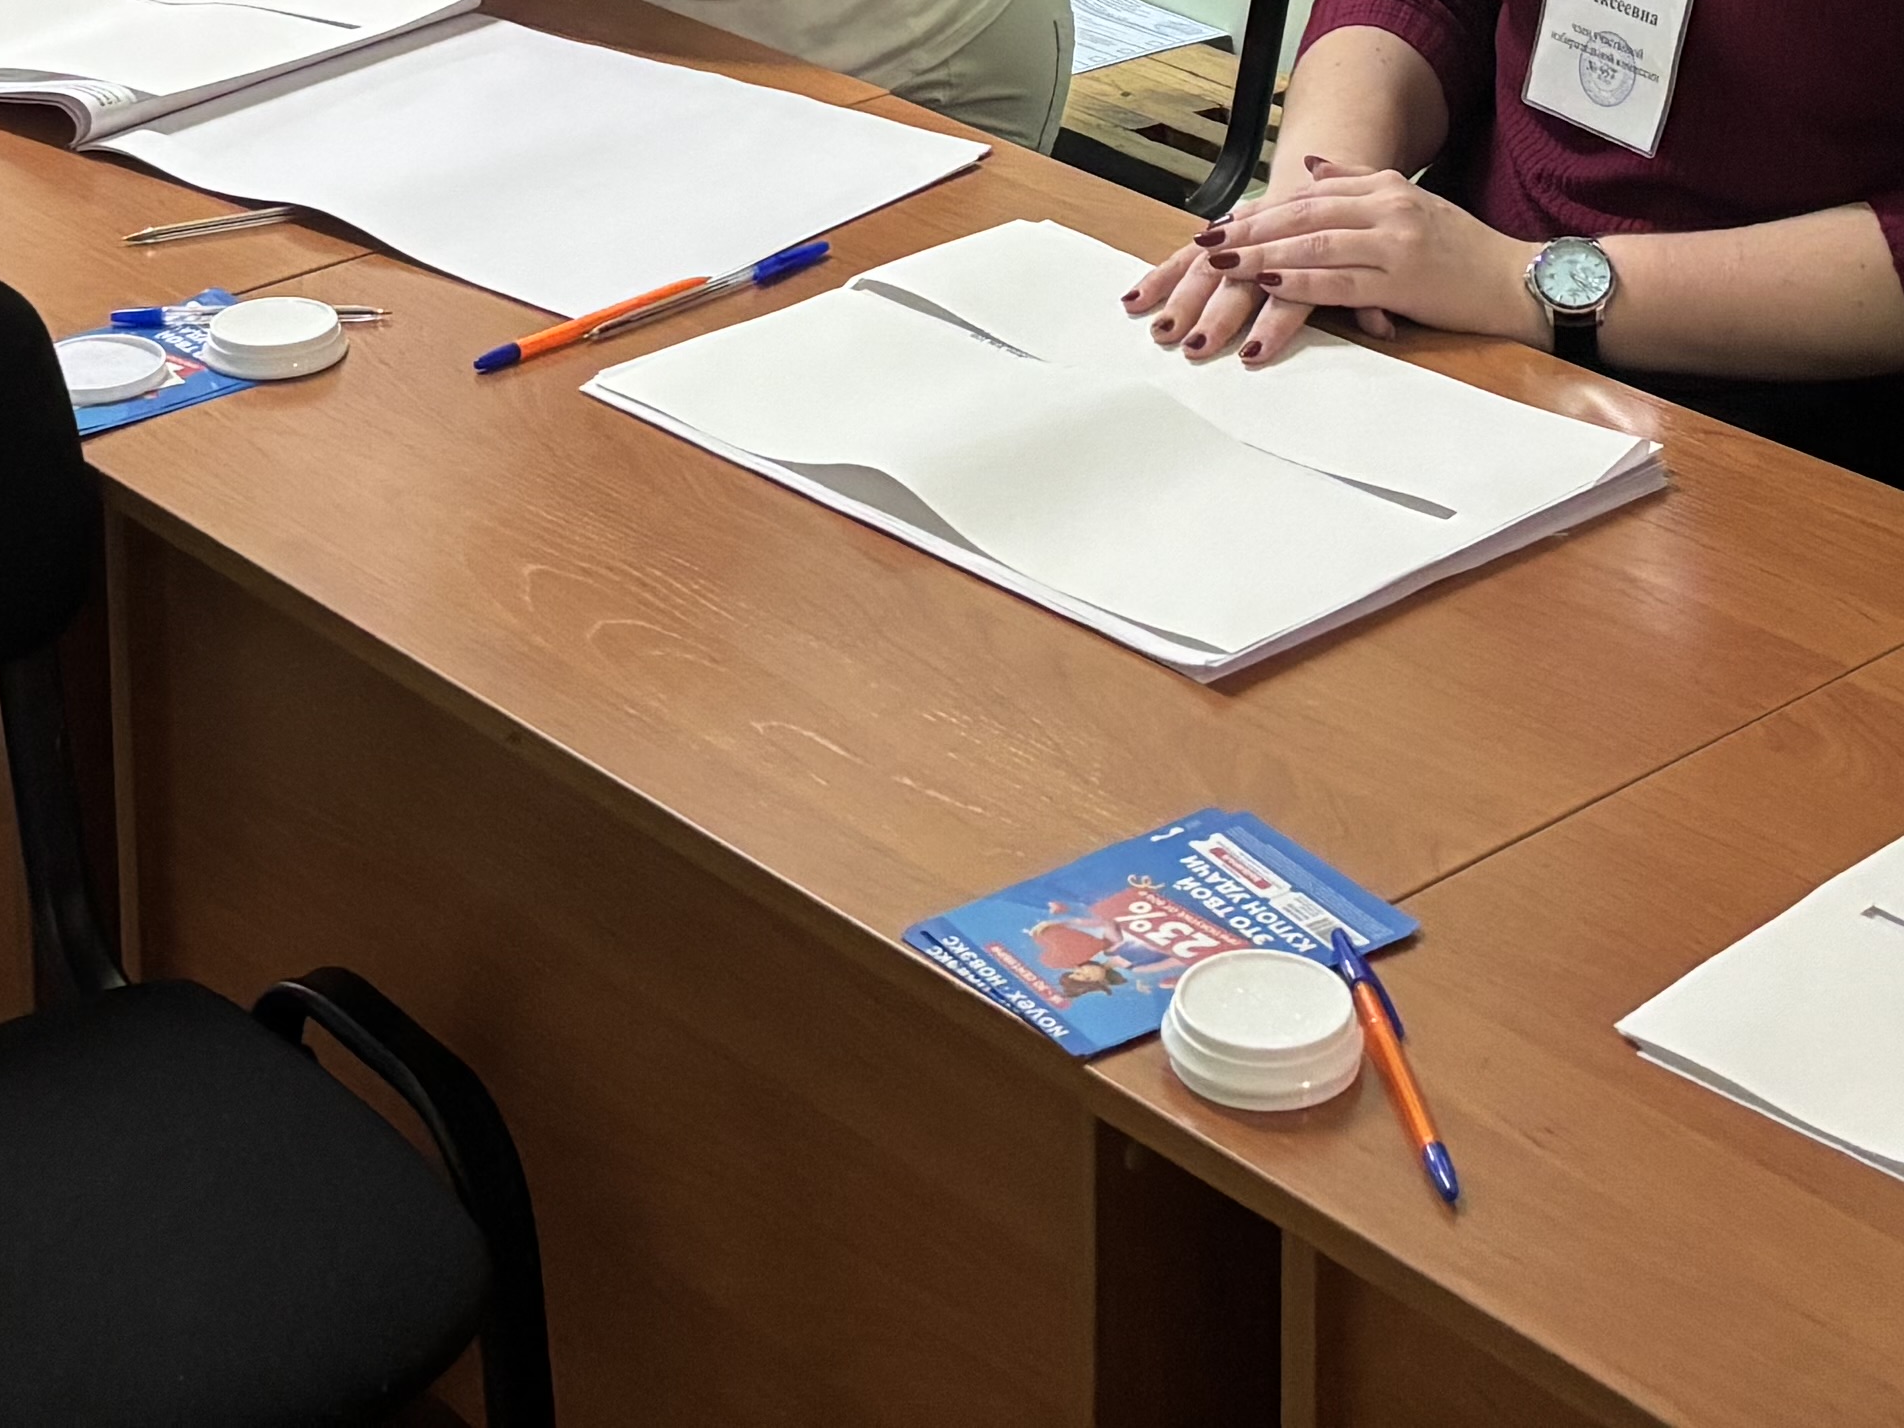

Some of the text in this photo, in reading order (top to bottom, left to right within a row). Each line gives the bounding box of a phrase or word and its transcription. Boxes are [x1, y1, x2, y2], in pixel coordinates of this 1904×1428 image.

[1179, 855, 1244, 903] УДАЧИ
[1114, 901, 1220, 958] 23%
[1172, 876, 1275, 946] ЭТО ТВОЙ
[1241, 900, 1317, 952] КУПОН
